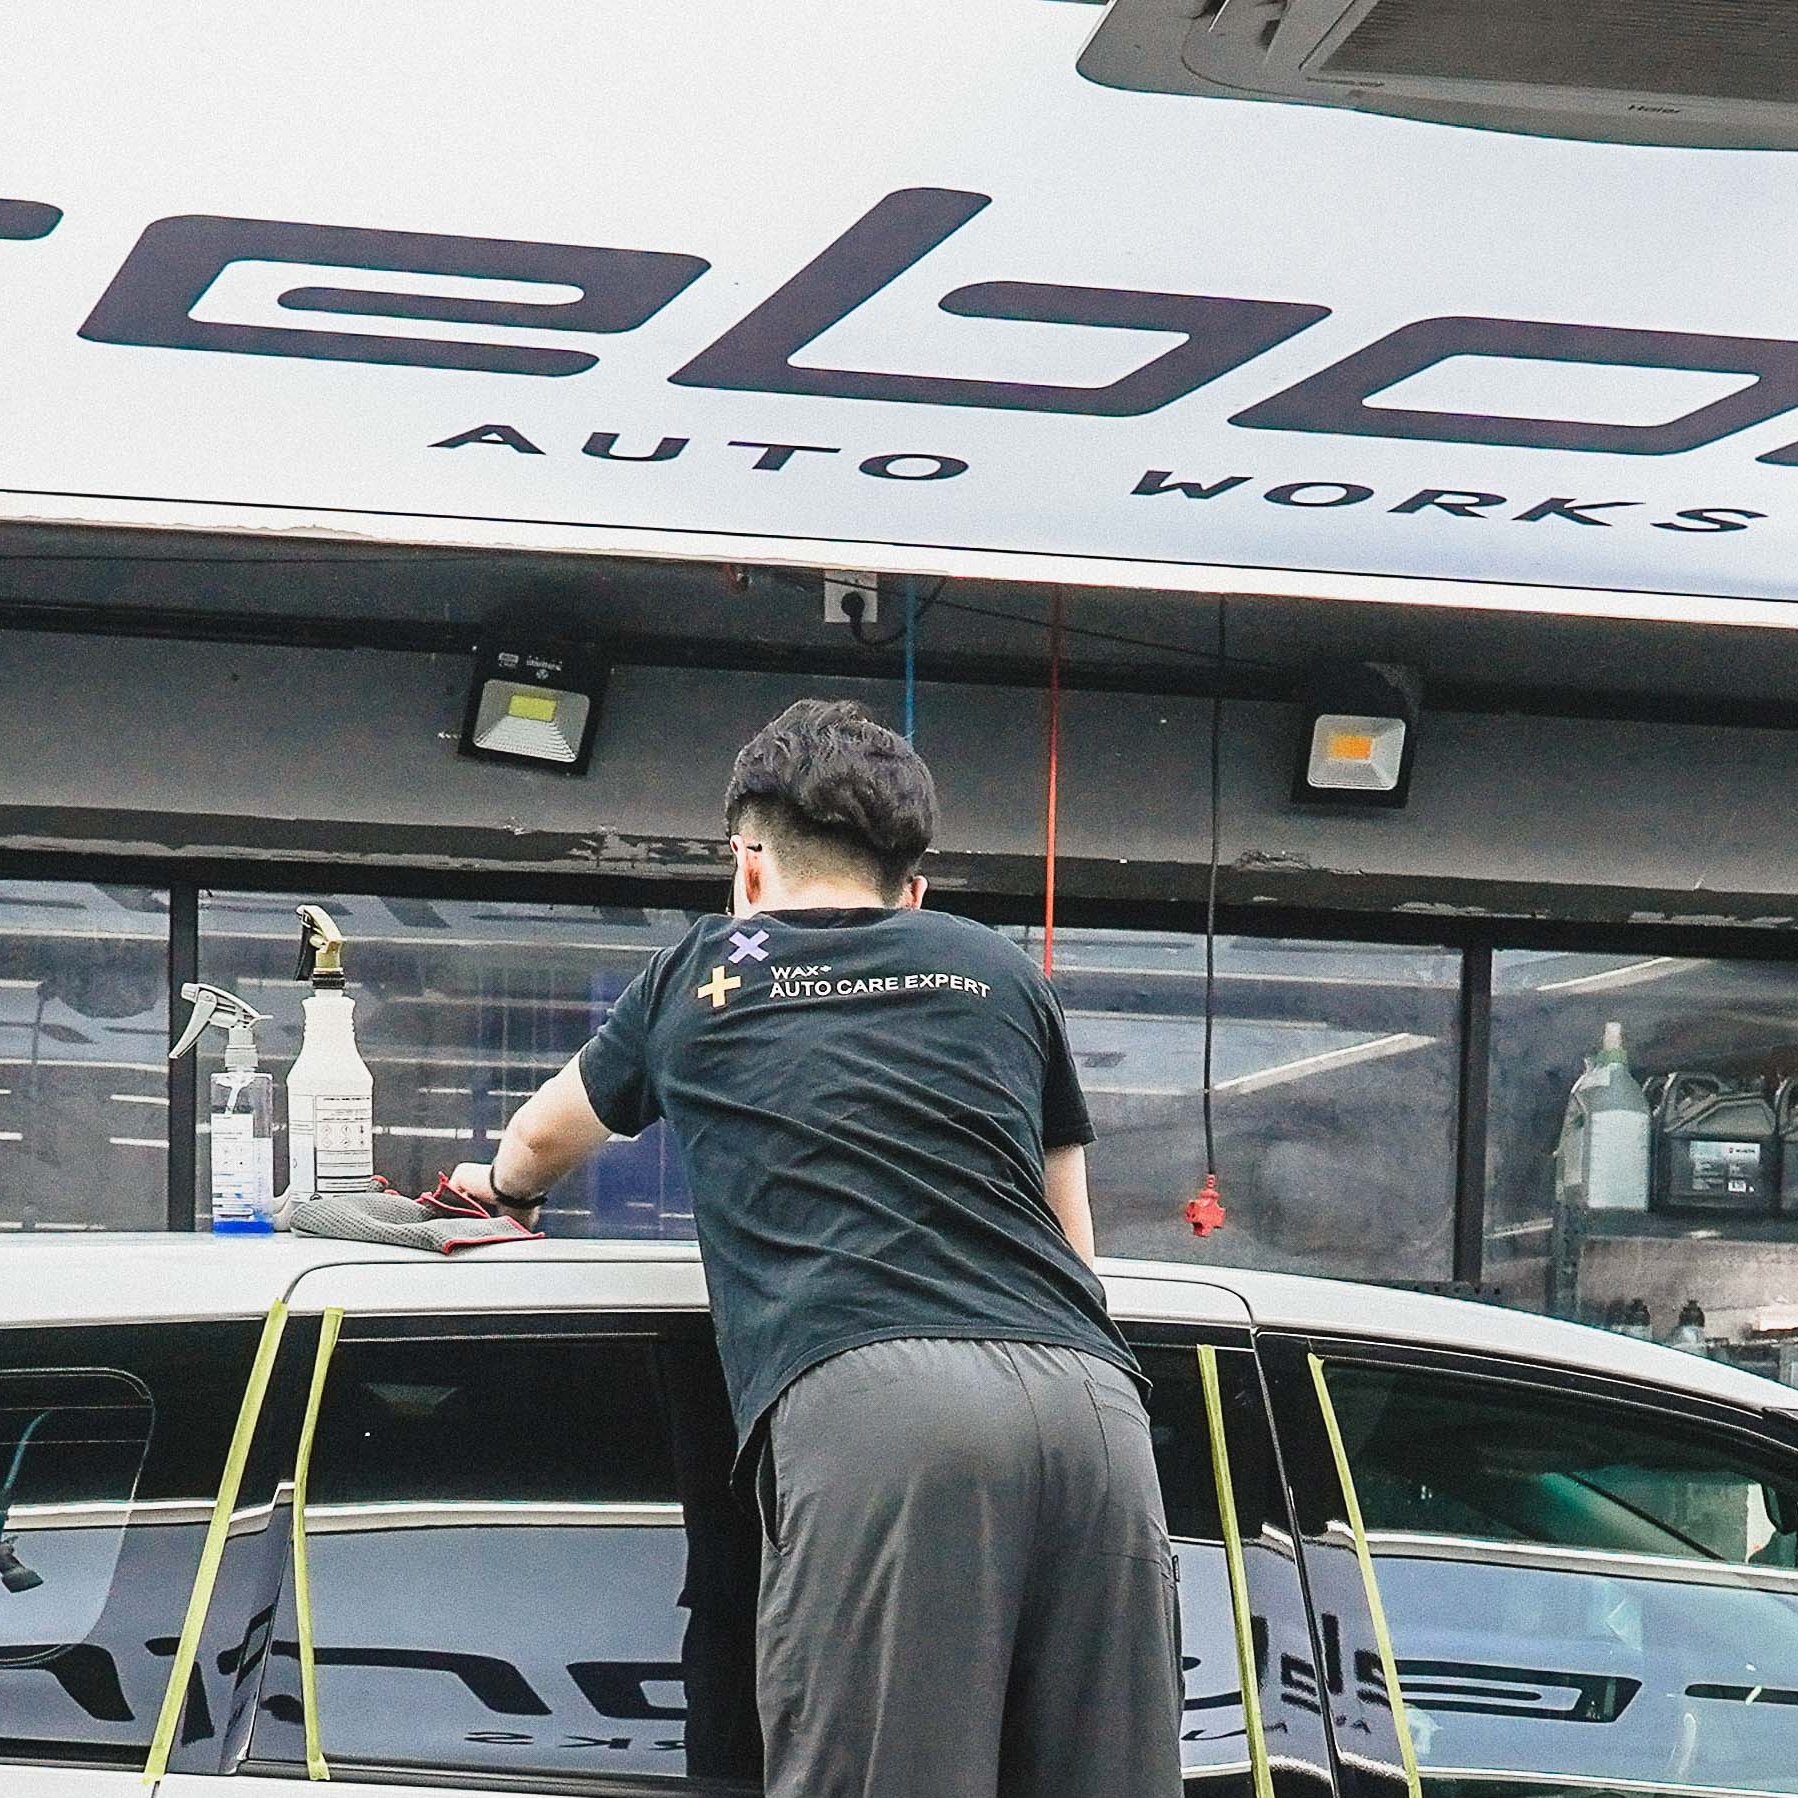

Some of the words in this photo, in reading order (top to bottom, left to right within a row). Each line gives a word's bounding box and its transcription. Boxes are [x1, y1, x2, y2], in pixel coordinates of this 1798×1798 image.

[428, 424, 969, 481] AUTO
[1130, 470, 1770, 534] WORKS
[769, 980, 832, 998] AUTO
[836, 977, 899, 995] CARE
[904, 973, 991, 998] EXPERT
